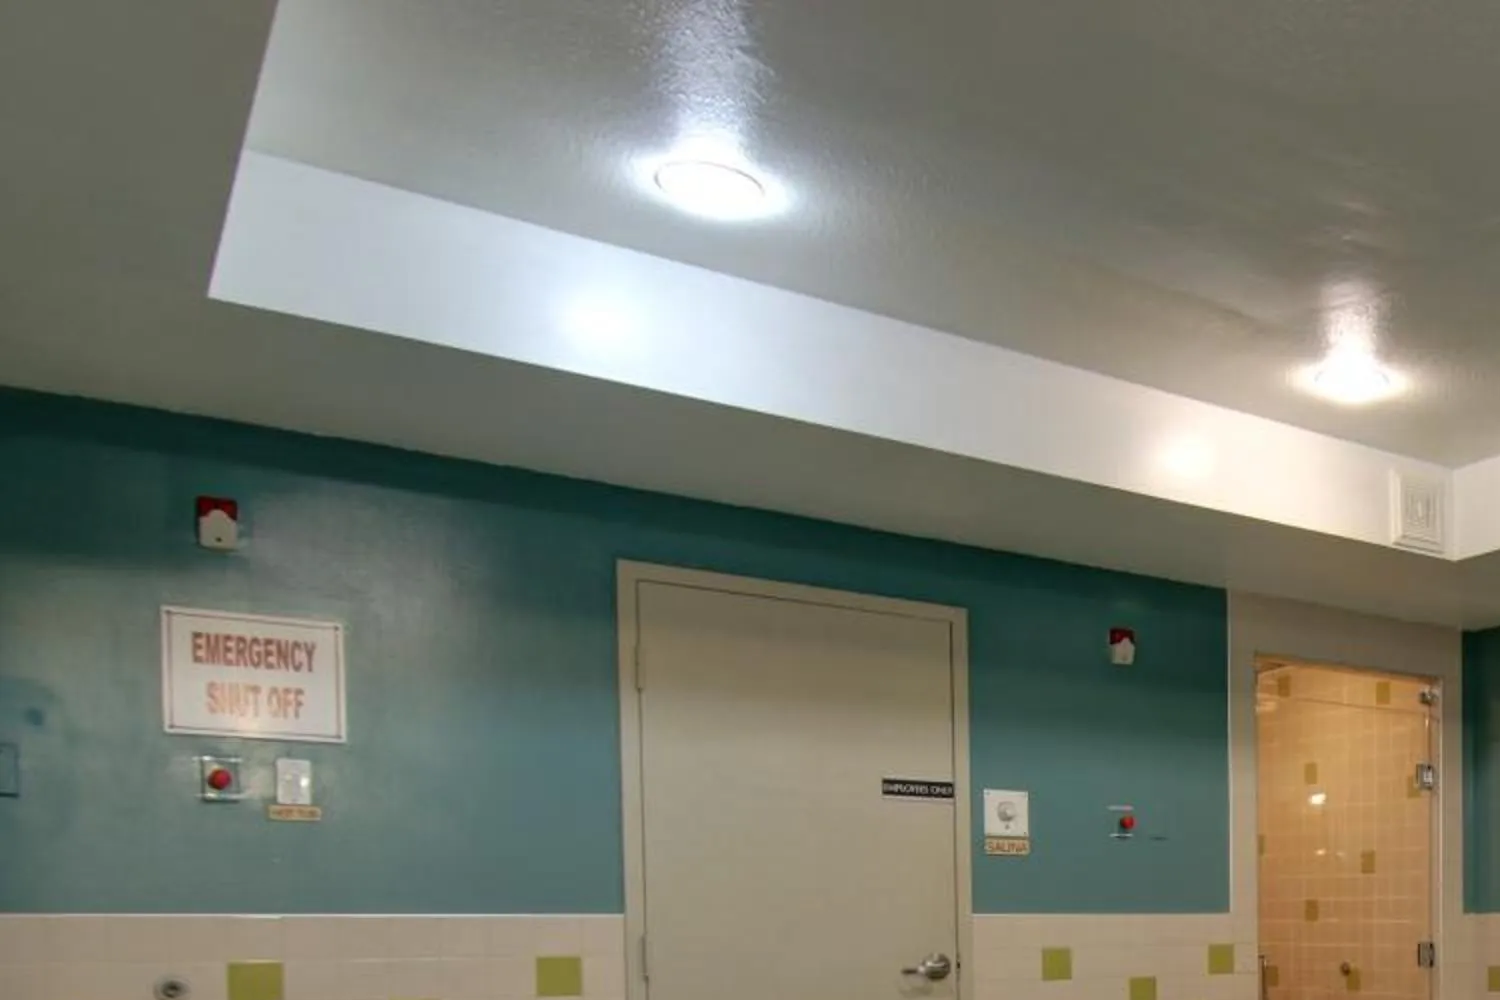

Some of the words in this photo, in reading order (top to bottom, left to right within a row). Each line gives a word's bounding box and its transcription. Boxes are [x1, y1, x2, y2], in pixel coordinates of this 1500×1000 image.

[191, 631, 317, 673] EMERGENCY
[205, 680, 262, 718] SHUT
[267, 686, 305, 720] OFF
